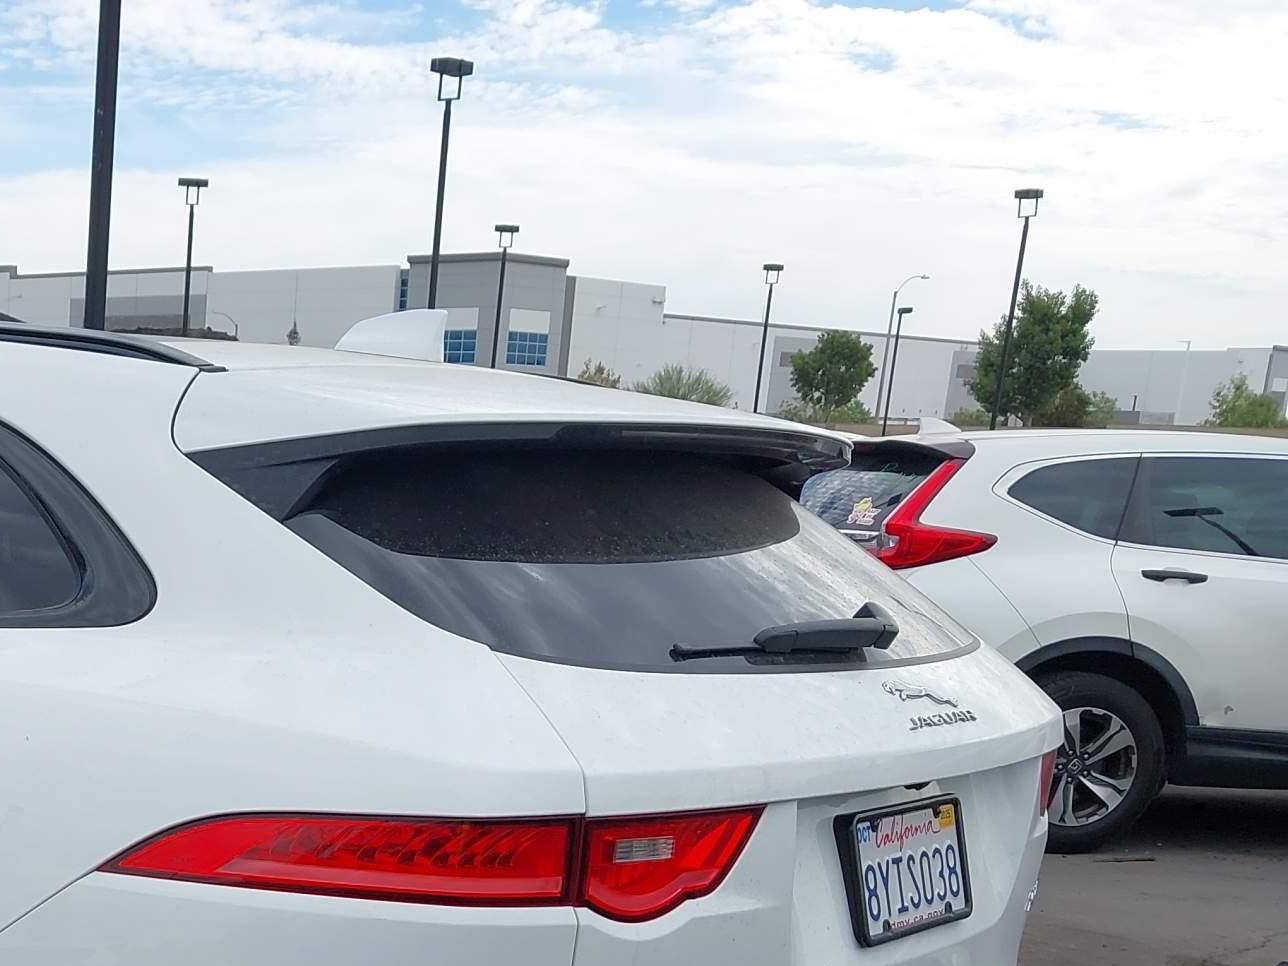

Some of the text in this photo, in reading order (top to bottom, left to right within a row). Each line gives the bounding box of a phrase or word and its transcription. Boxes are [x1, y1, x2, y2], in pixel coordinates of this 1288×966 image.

[909, 710, 977, 731] JAGUAR
[875, 815, 941, 852] California
[864, 844, 961, 922] 8YIS038
